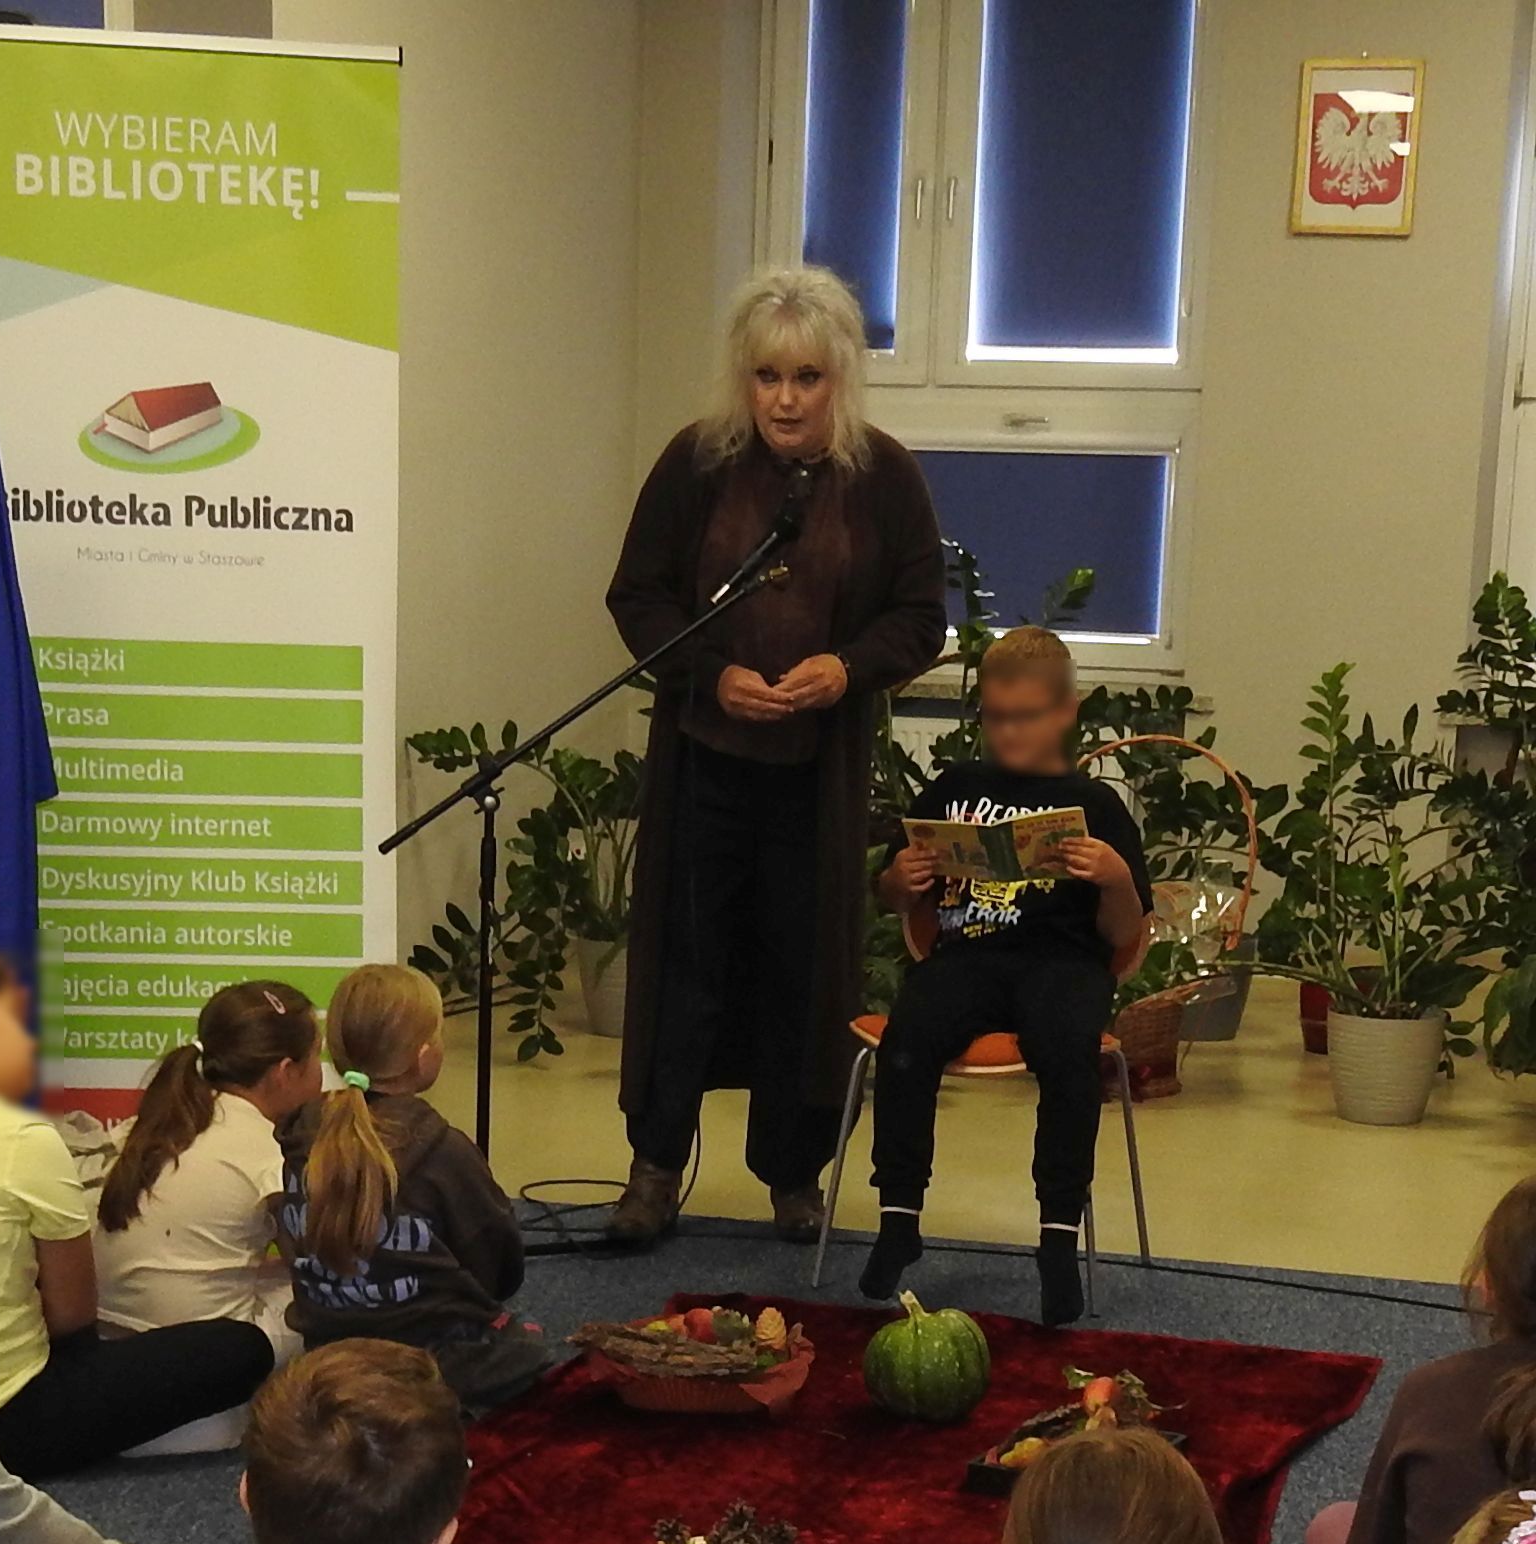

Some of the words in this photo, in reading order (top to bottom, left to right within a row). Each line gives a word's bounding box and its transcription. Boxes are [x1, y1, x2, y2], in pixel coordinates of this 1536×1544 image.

[54, 110, 279, 157] WYBIERAM
[15, 153, 321, 220] BIBLIOTEKĘ!
[5, 487, 172, 528] iblioteka
[184, 494, 355, 533] Publiczna
[77, 546, 125, 563] Miasta
[138, 548, 177, 565] Gminy
[183, 554, 194, 564] w
[38, 647, 125, 677] Książki
[42, 702, 110, 726] Prasa
[40, 810, 163, 841] Darmowy
[170, 813, 272, 837] internet
[41, 867, 183, 898] Dyskusyjny
[191, 869, 246, 893] Klub
[255, 871, 339, 899] Książki
[43, 920, 166, 944] potkania
[175, 923, 293, 947] autorskie
[63, 974, 129, 1001] ajęcia
[137, 974, 249, 998] edukac
[64, 1027, 168, 1056] arsztaty
